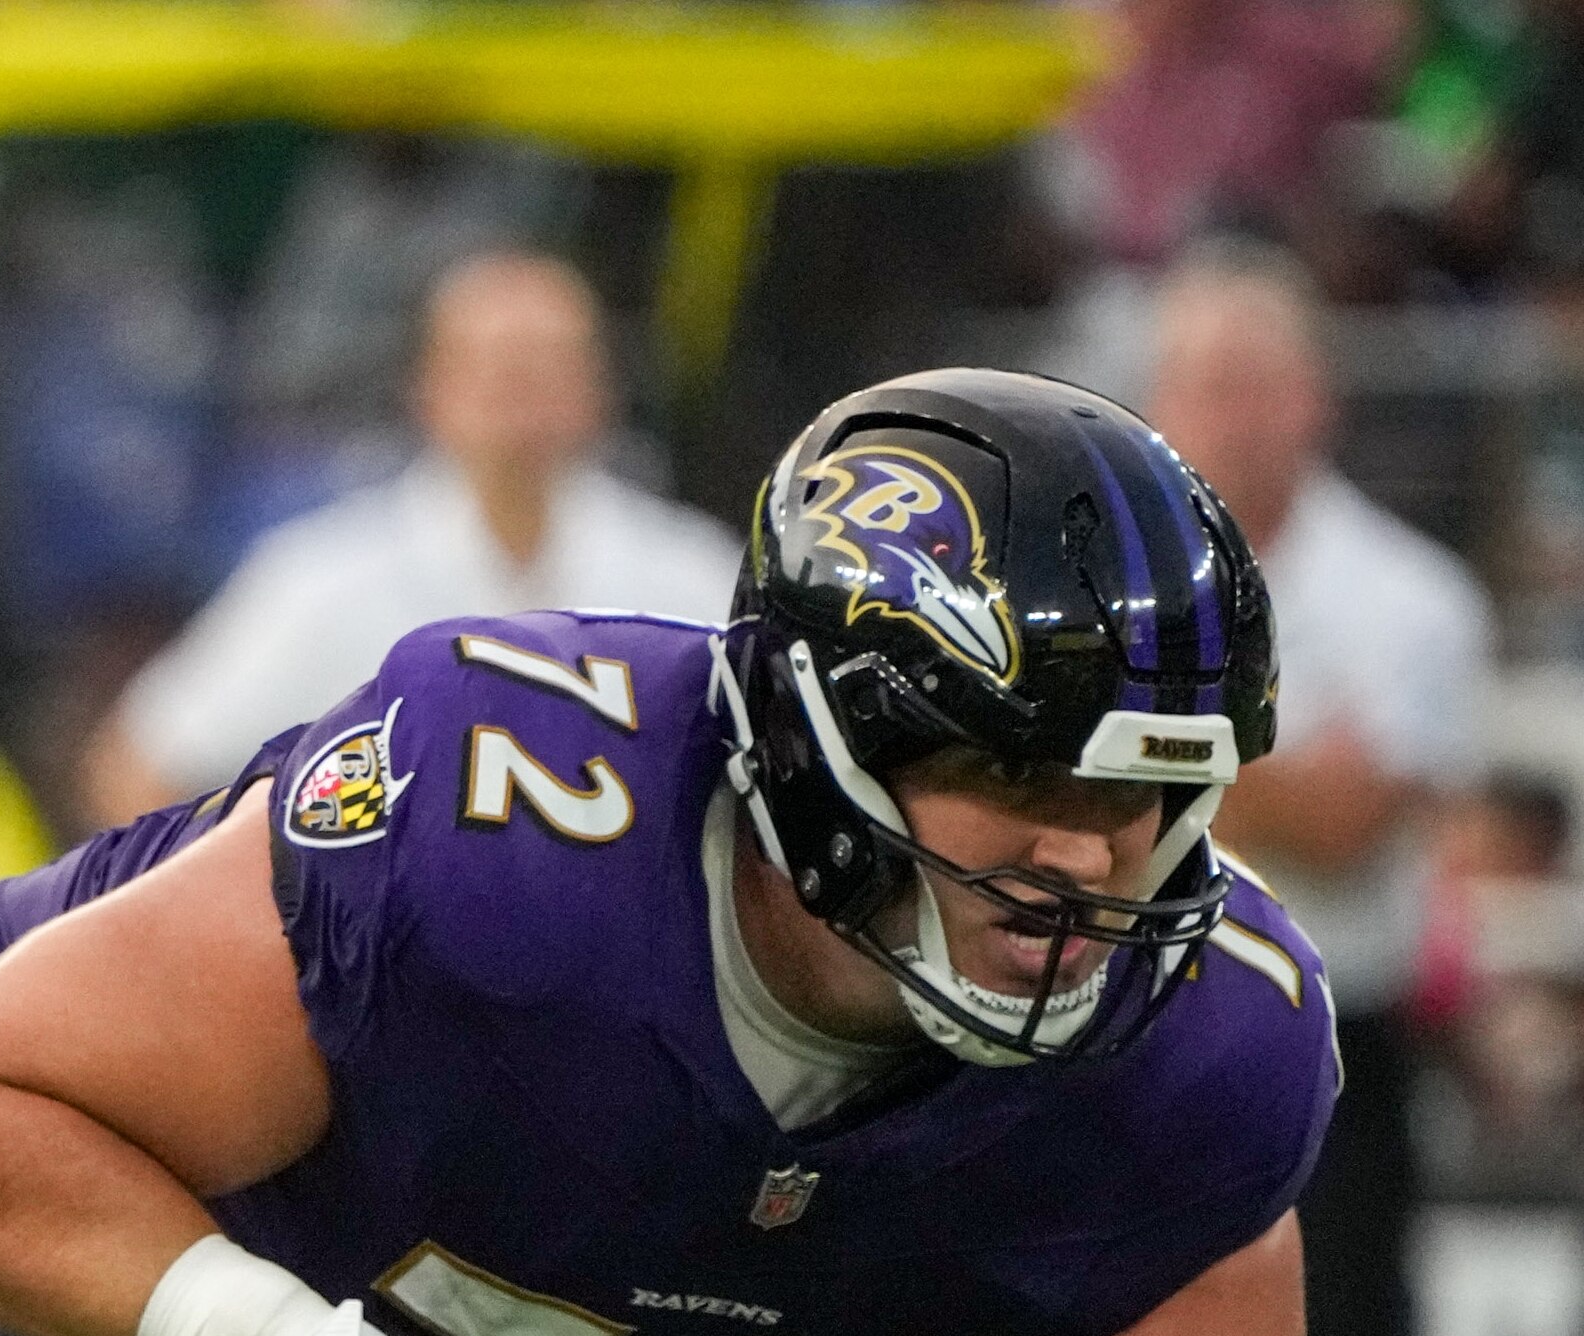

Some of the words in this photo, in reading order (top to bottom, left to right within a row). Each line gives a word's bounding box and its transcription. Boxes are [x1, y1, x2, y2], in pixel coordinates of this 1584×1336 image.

[454, 634, 639, 842] 72
[1140, 735, 1214, 763] RAVENS
[631, 1287, 783, 1326] RAVENS
